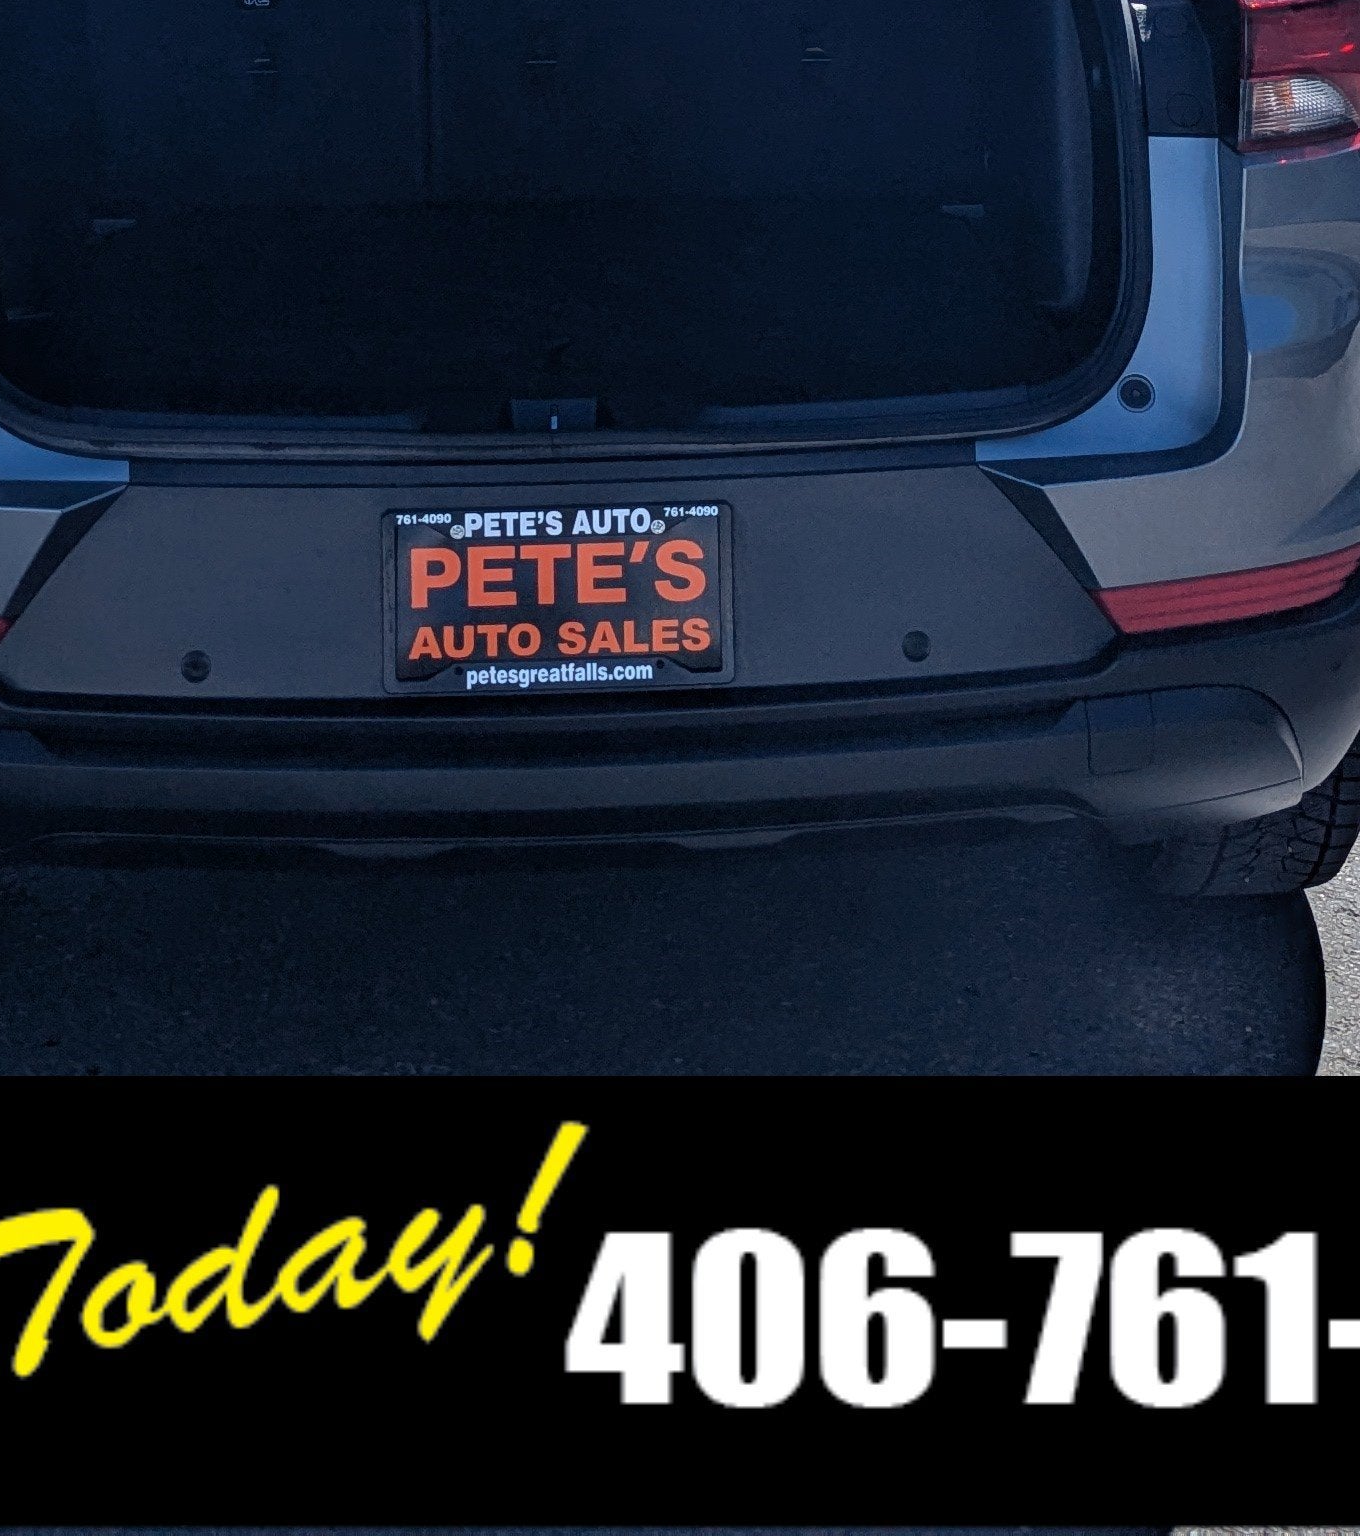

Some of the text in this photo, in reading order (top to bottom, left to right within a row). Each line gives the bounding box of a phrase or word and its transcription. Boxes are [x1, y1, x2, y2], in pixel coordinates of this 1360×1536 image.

[395, 505, 719, 538] 761-4090 PETE'S AUTO 761-4090
[409, 539, 708, 610] PETE'S
[408, 617, 712, 661] AUTO SALES
[465, 662, 654, 690] petesgreatfalls.com
